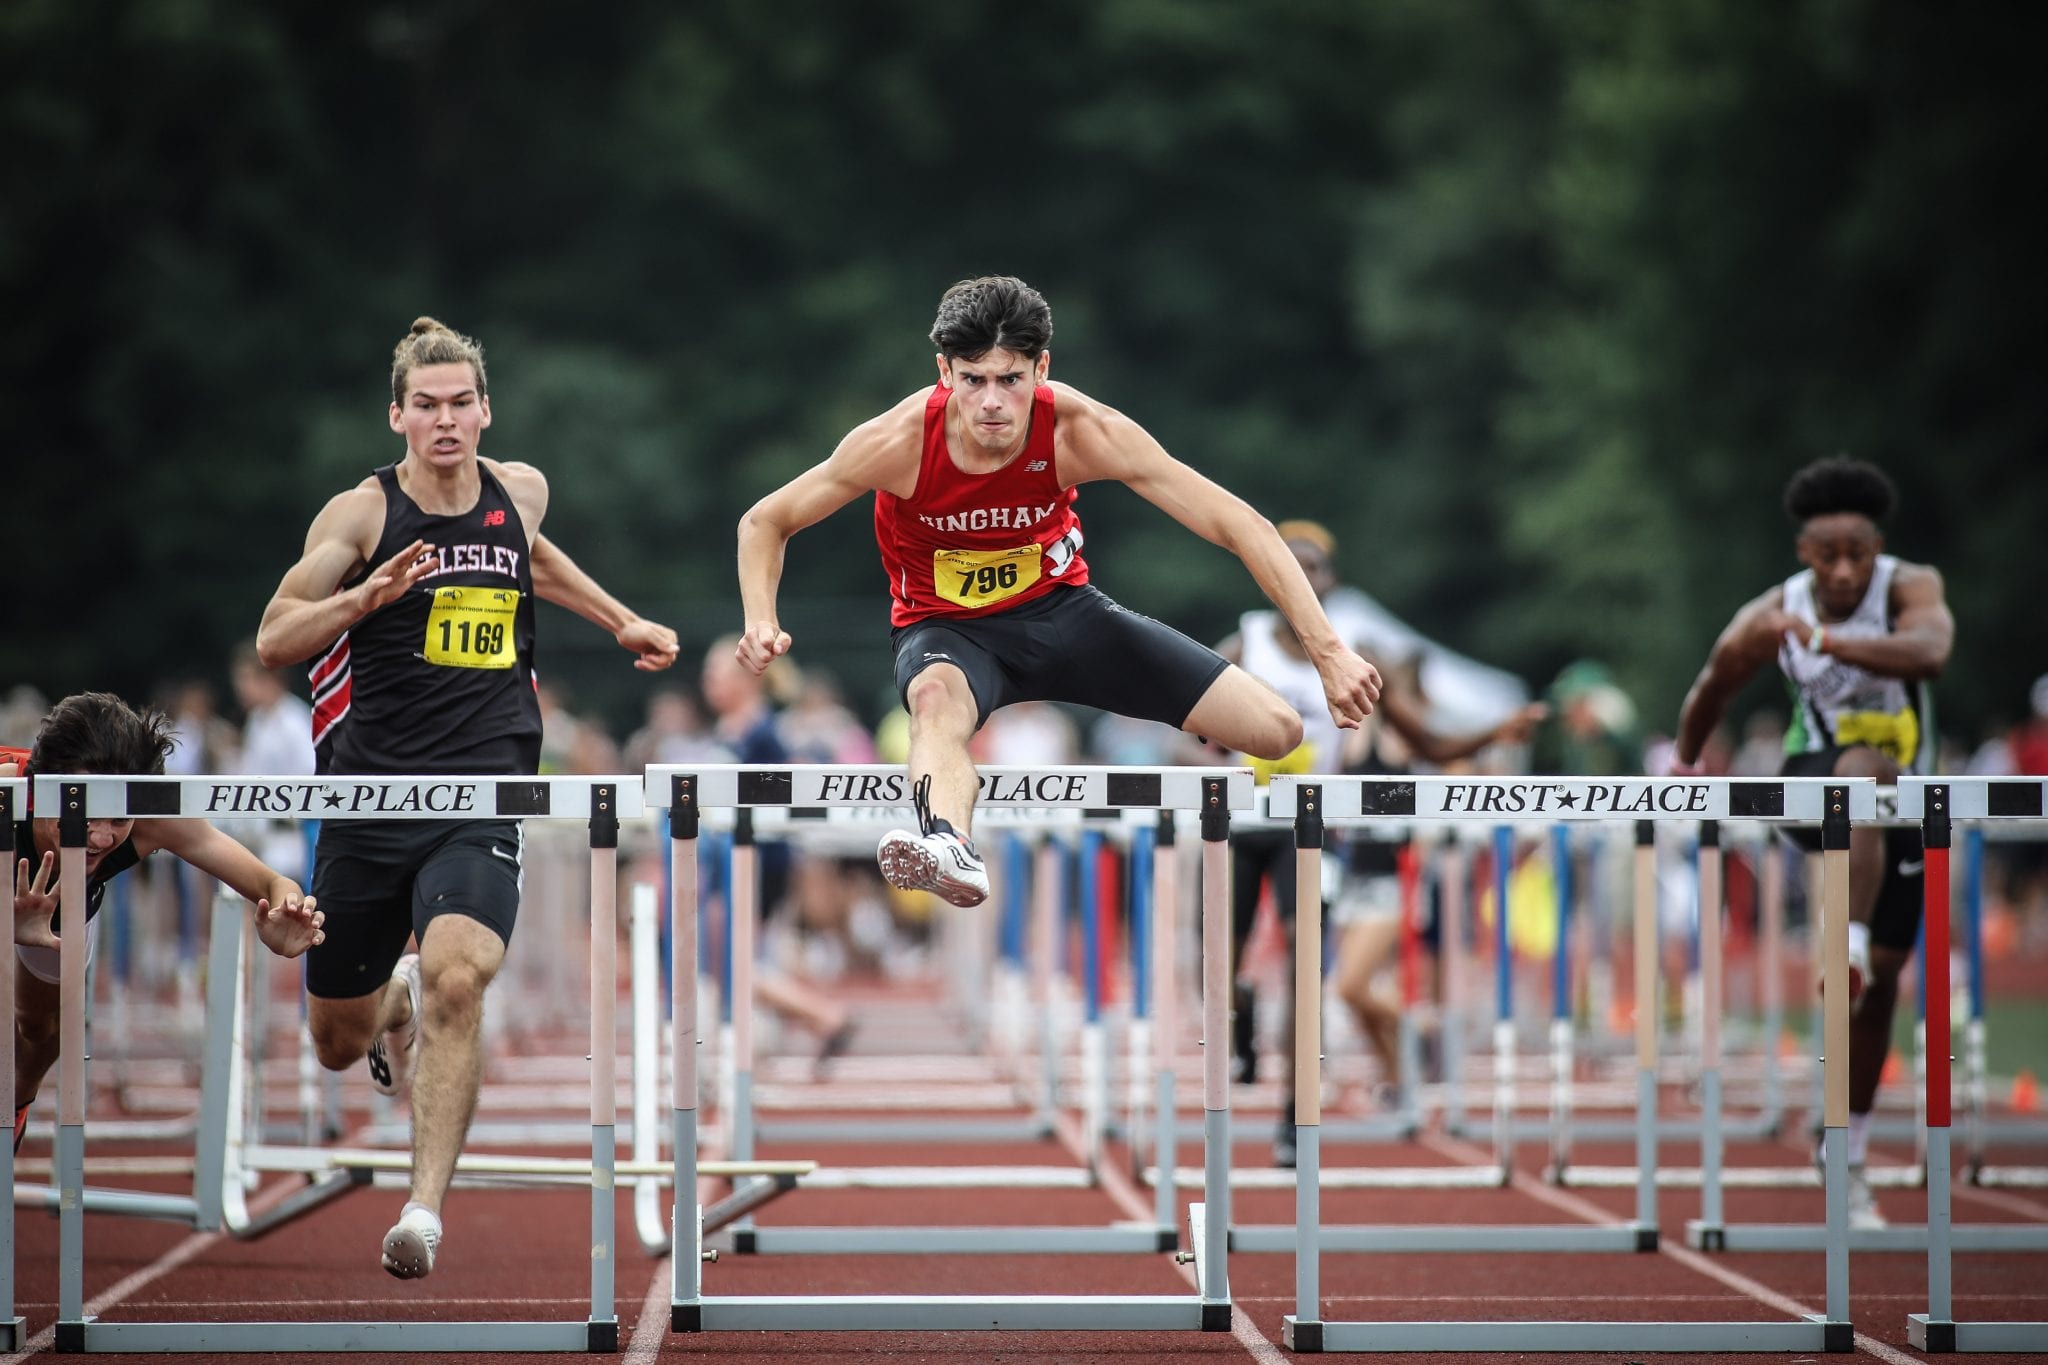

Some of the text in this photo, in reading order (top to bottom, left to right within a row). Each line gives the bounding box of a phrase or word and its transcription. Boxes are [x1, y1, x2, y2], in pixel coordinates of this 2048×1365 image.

[918, 502, 1056, 531] INGHAM
[411, 544, 519, 579] LLESLEY
[956, 563, 1018, 597] 796
[439, 620, 504, 655] 1169
[347, 784, 476, 811] PLACE
[816, 774, 918, 801] FIRS
[1581, 784, 1710, 812] PLACE
